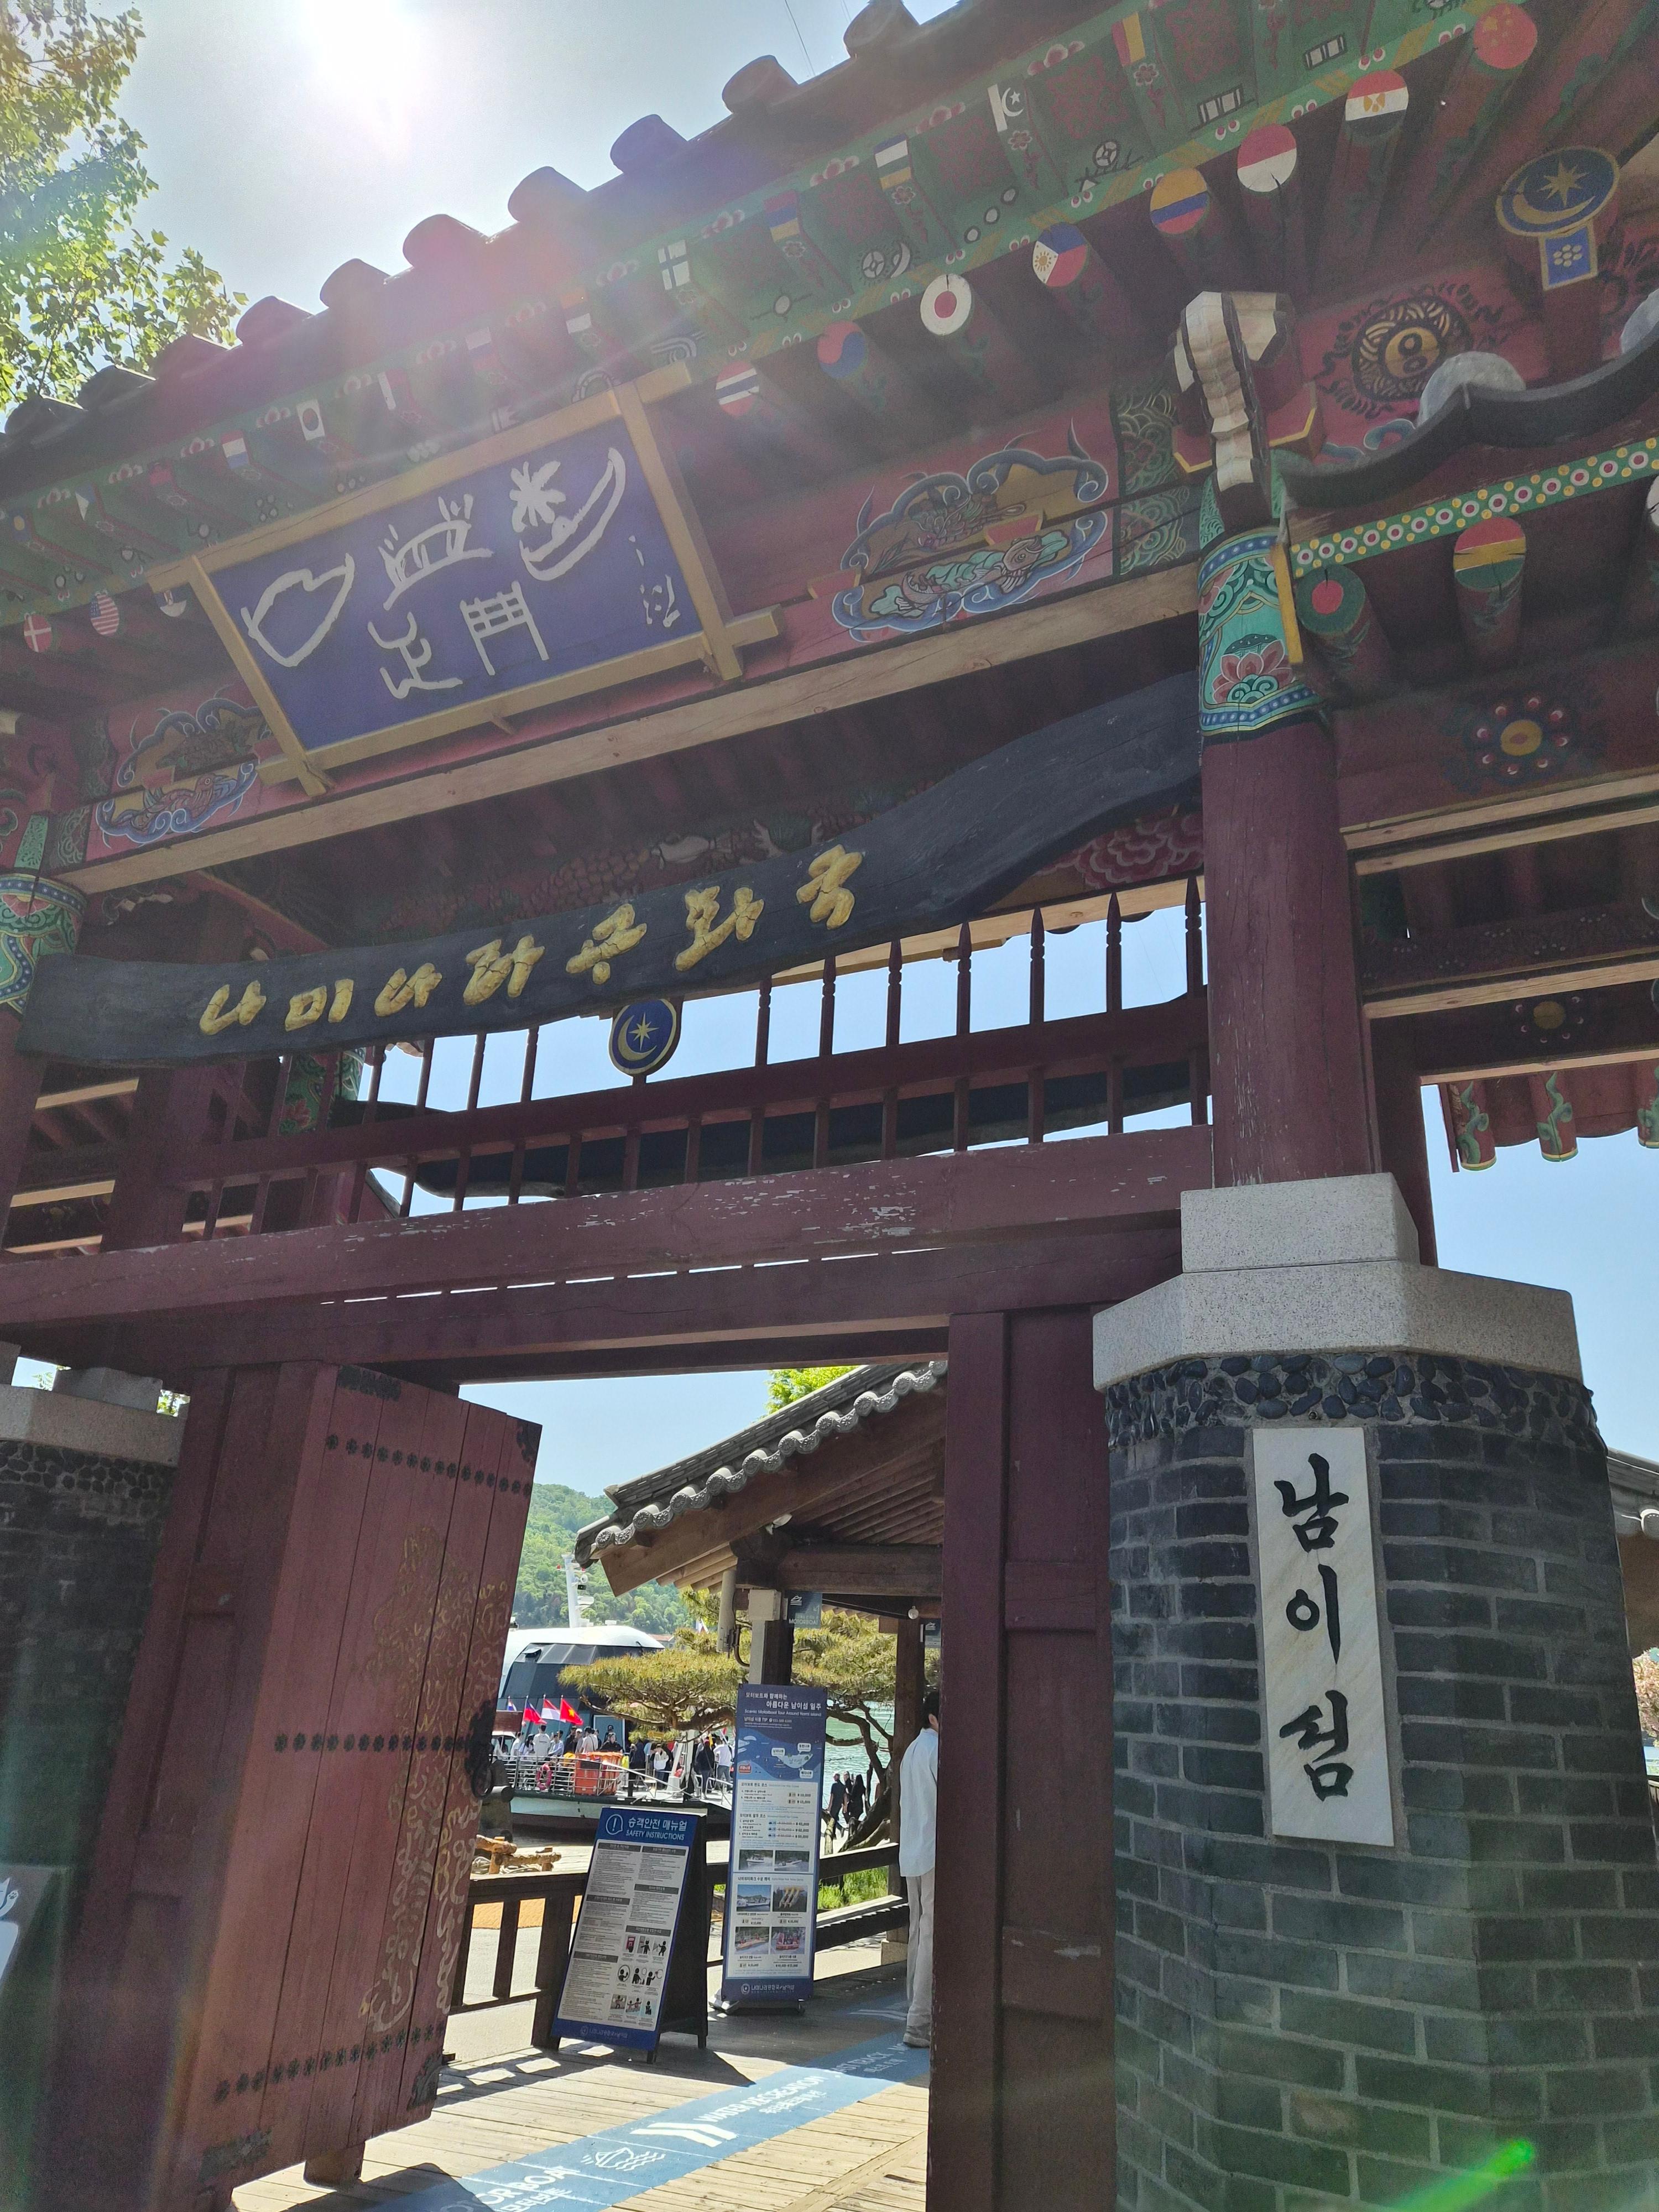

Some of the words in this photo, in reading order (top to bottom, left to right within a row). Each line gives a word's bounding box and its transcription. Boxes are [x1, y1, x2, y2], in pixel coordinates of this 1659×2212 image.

[198, 843, 863, 1035] 나미나라공화국
[1274, 1453, 1354, 1801] 남이섬
[766, 1700, 789, 1709] 아름다운
[628, 1817, 661, 1829] 승객안전
[662, 1820, 687, 1832] 매뉴얼
[645, 1831, 685, 1841] INSTRUCTIONS
[693, 2103, 756, 2123] WATER
